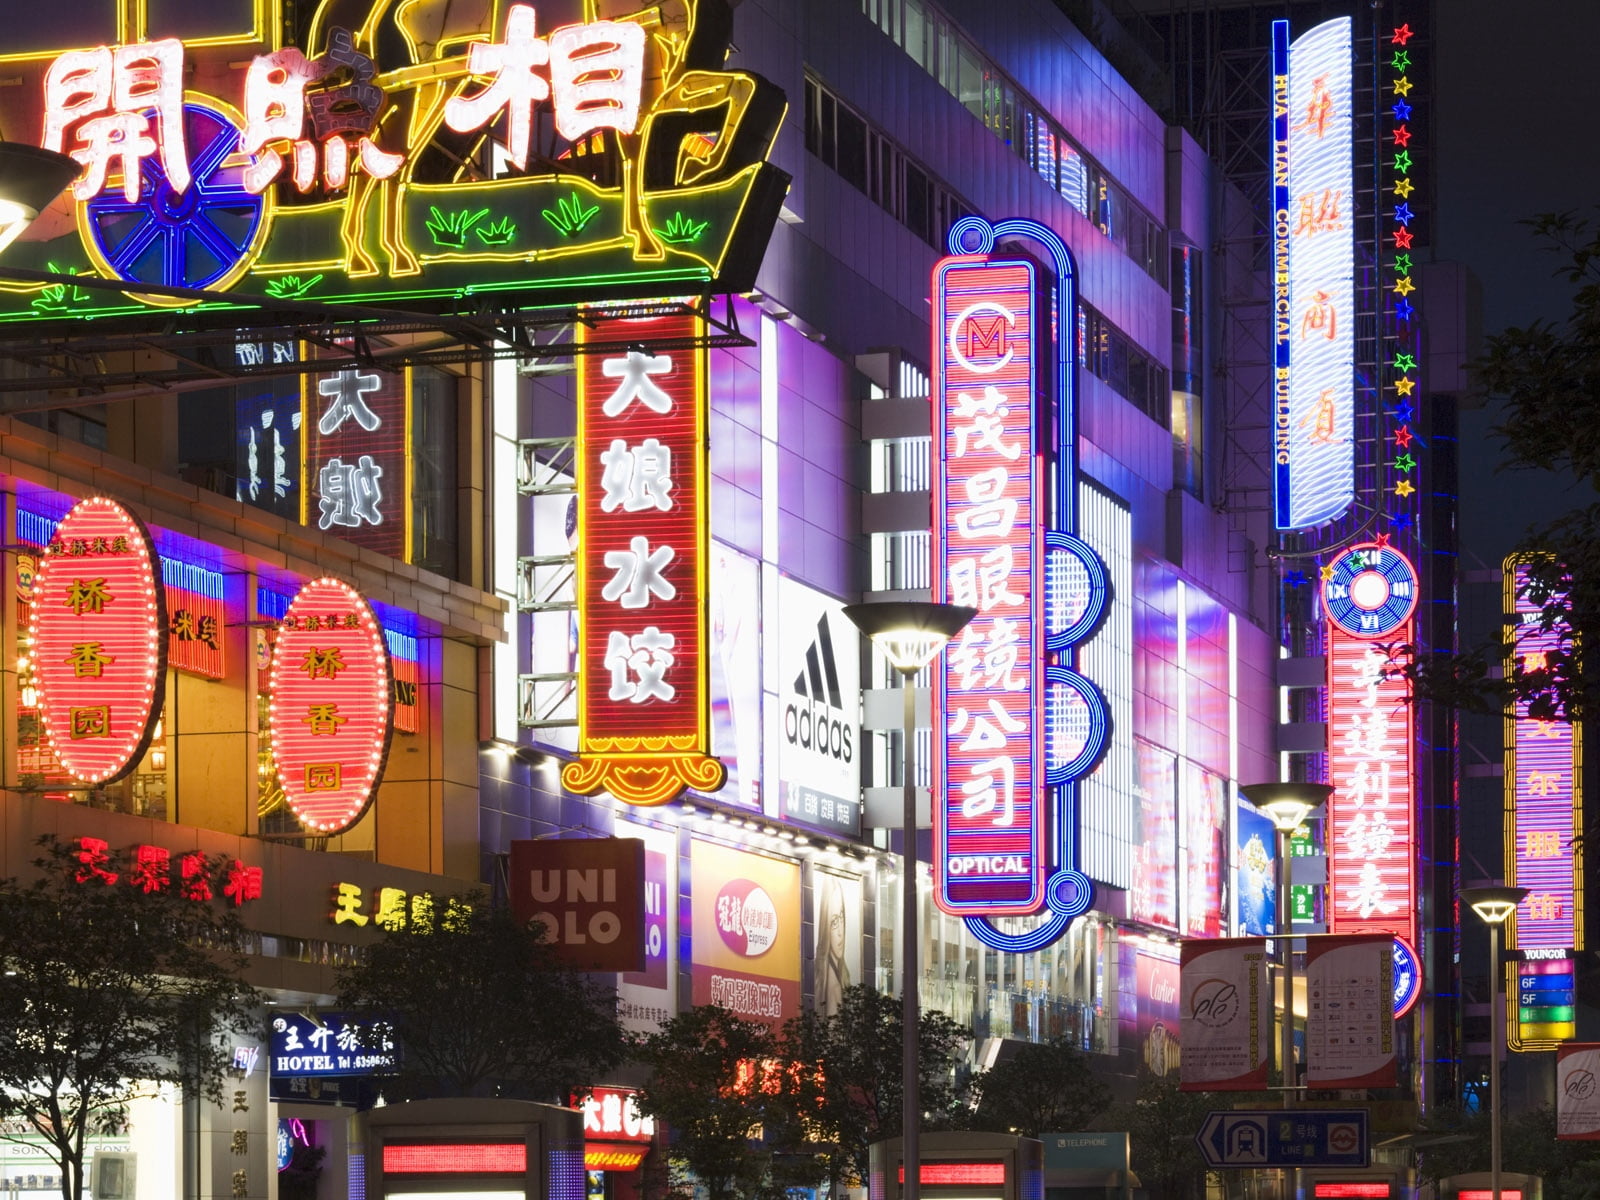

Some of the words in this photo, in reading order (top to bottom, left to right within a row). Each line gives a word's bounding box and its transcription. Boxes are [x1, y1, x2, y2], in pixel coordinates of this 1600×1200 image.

[1275, 75, 1288, 117] HUA
[1275, 141, 1288, 186] LIAN
[1276, 209, 1289, 345] COMMERCIAL
[1277, 368, 1290, 465] BUILDING
[602, 346, 676, 704] 大娘水饺
[948, 386, 1026, 826] 茂昌眼镜公司
[64, 578, 114, 738] 桥香园
[301, 647, 348, 792] 桥香园
[785, 703, 852, 764] adidas
[948, 857, 1027, 874] OPTICAL
[531, 869, 616, 902] UNI
[645, 881, 661, 916] NI
[528, 911, 621, 944] QLO
[1524, 949, 1566, 960] YOUNGOR
[1522, 978, 1536, 988] 6F
[1522, 994, 1536, 1004] 5F
[1522, 1010, 1536, 1020] 4F
[277, 1056, 334, 1071] HOTEL
[1067, 1138, 1107, 1146] TELEPHONE
